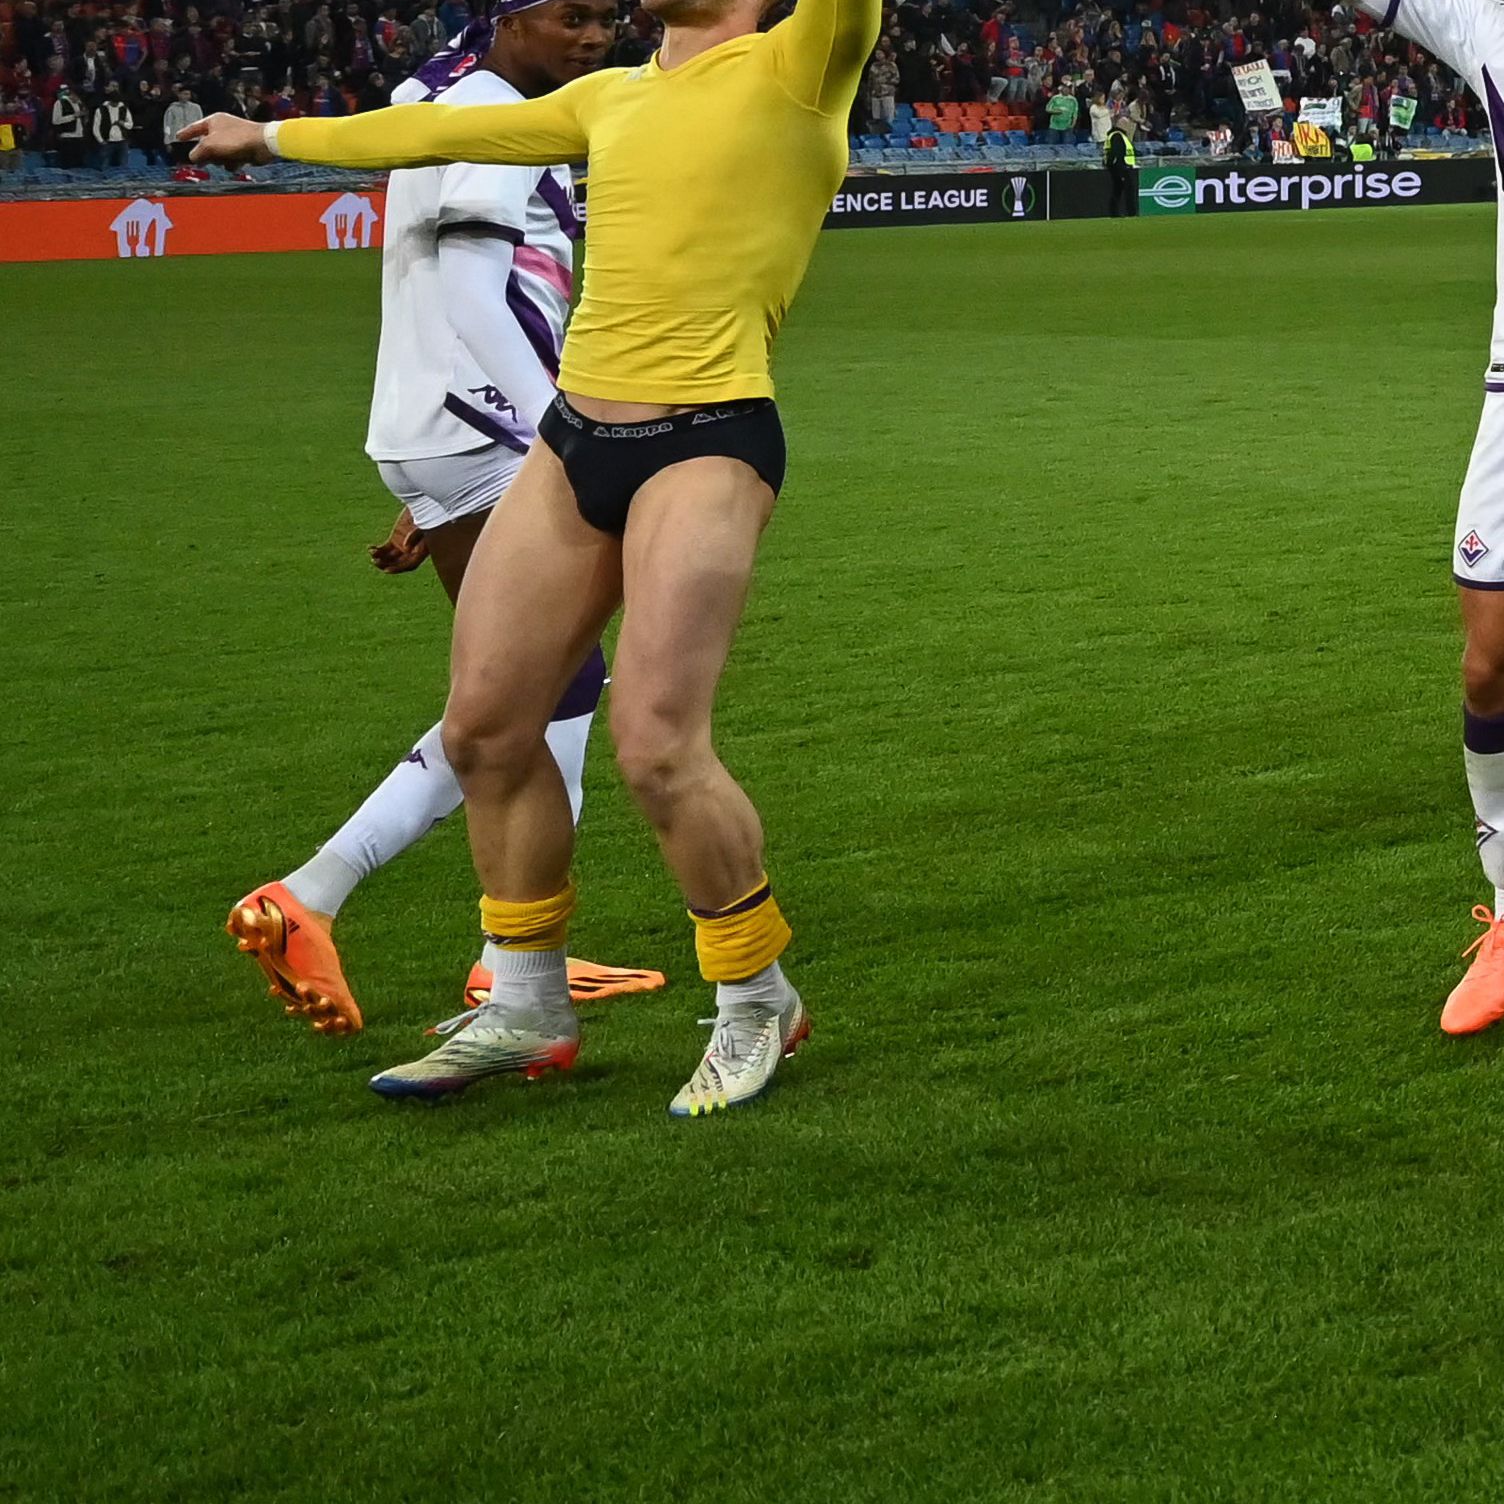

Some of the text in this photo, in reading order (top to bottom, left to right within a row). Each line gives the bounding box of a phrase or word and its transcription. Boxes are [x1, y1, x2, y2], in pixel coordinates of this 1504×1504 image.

[1152, 164, 1422, 210] enterprise
[901, 188, 989, 211] LEAGUE
[611, 422, 674, 439] Kappa
